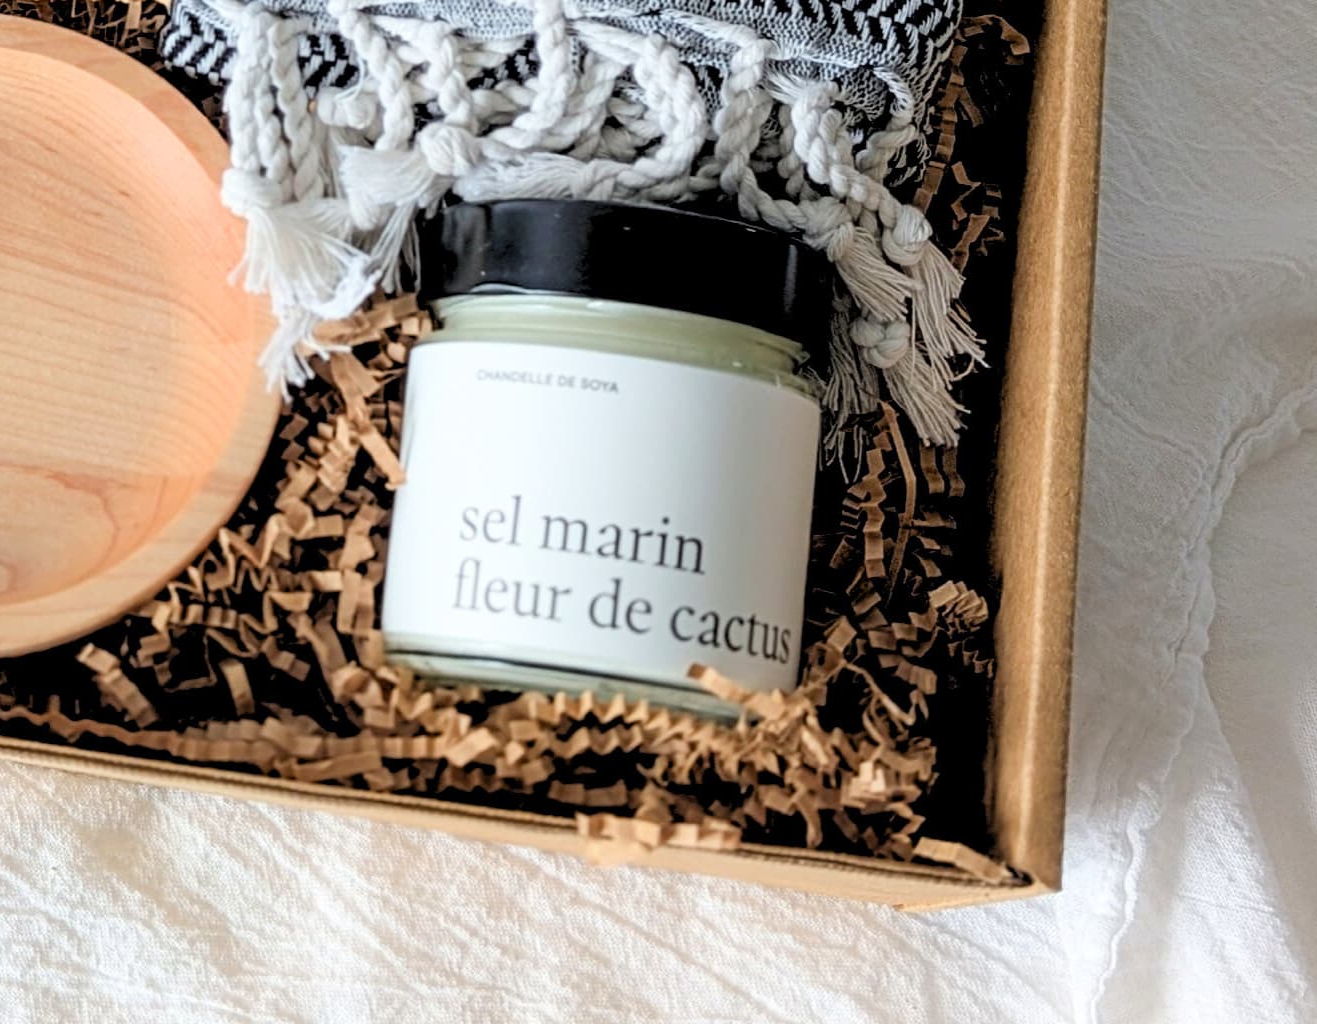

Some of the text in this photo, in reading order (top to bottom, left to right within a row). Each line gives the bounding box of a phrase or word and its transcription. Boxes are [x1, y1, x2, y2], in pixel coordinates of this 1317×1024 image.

[476, 369, 619, 394] CHANDELLE DE SOYA
[459, 495, 706, 576] sel marin
[452, 557, 792, 666] fleur de cactus
